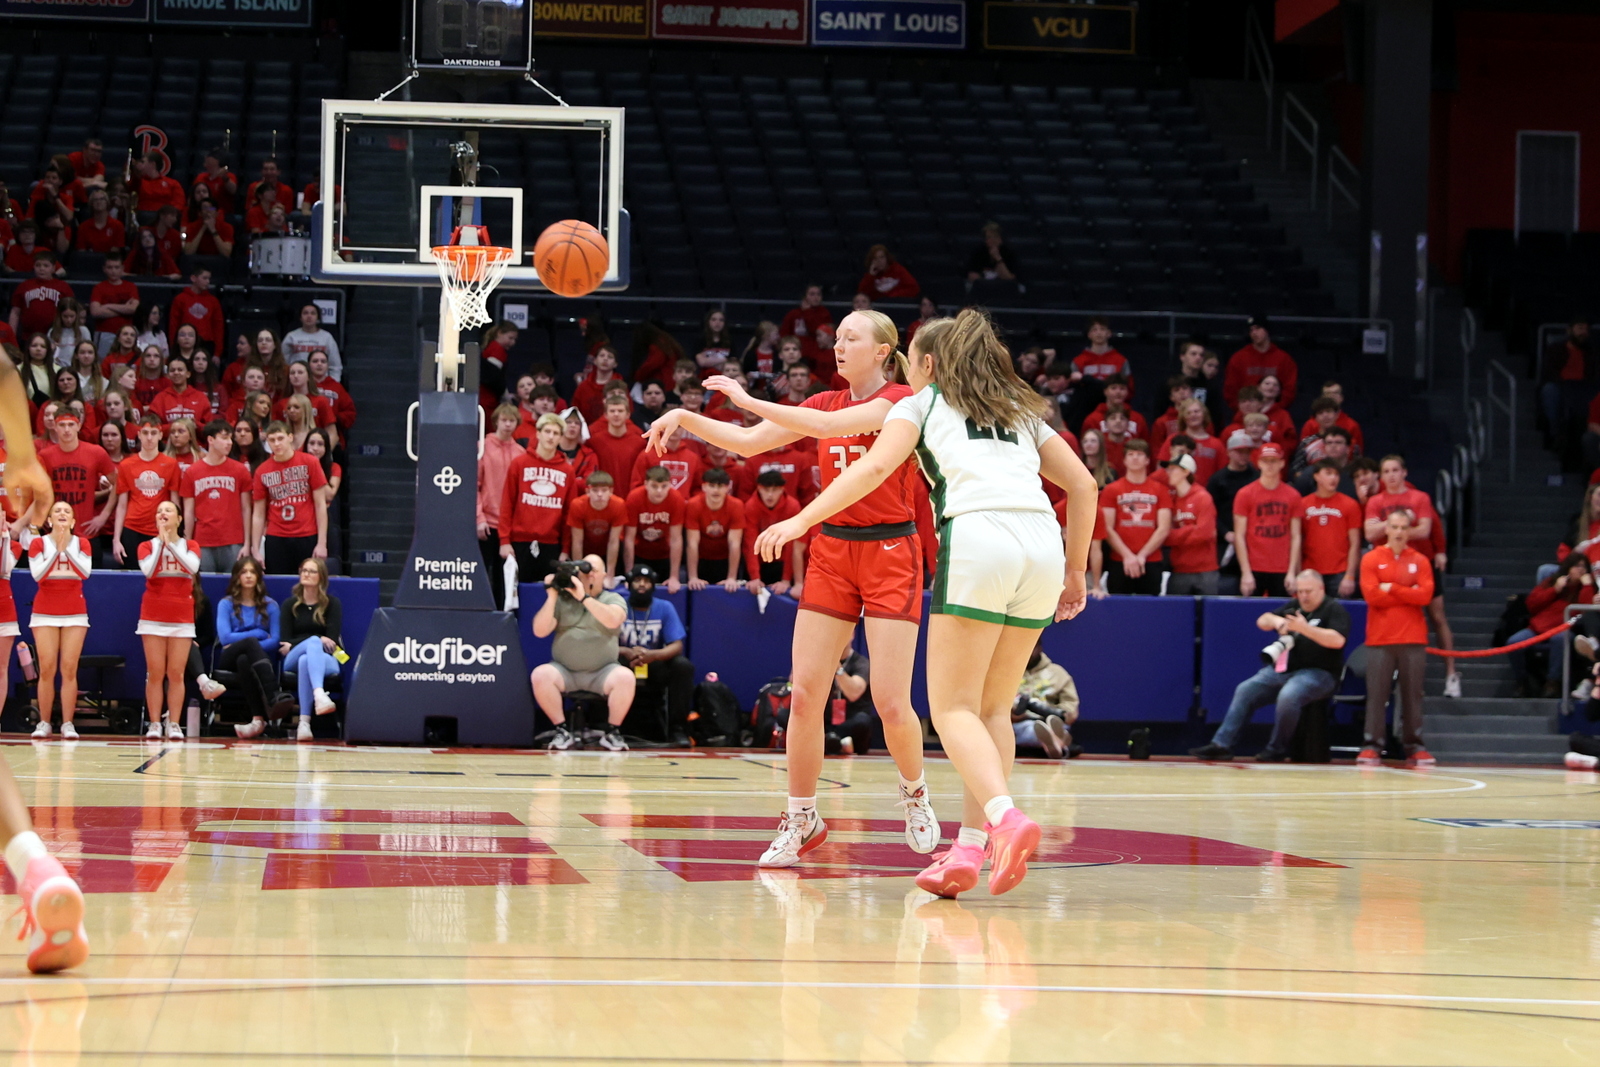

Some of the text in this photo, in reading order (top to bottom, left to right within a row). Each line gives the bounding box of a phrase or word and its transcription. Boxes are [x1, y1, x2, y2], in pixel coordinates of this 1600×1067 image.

[233, 0, 303, 12] ISLAND
[661, 5, 713, 26] SAINT
[819, 11, 960, 33] SAINT LOUIS
[1031, 16, 1090, 39] VCU
[443, 58, 502, 67] DAKTRONICS
[52, 465, 87, 482] STATE
[283, 464, 310, 483] STATE
[523, 466, 567, 487] BELLEVUE
[195, 475, 237, 498] BUCKEYES
[521, 492, 563, 509] FOOTBALL
[364, 551, 384, 563] 108
[414, 556, 479, 574] Premier
[418, 573, 473, 592] Health
[383, 636, 508, 670] altafiber
[394, 670, 496, 685] connecting dayton
